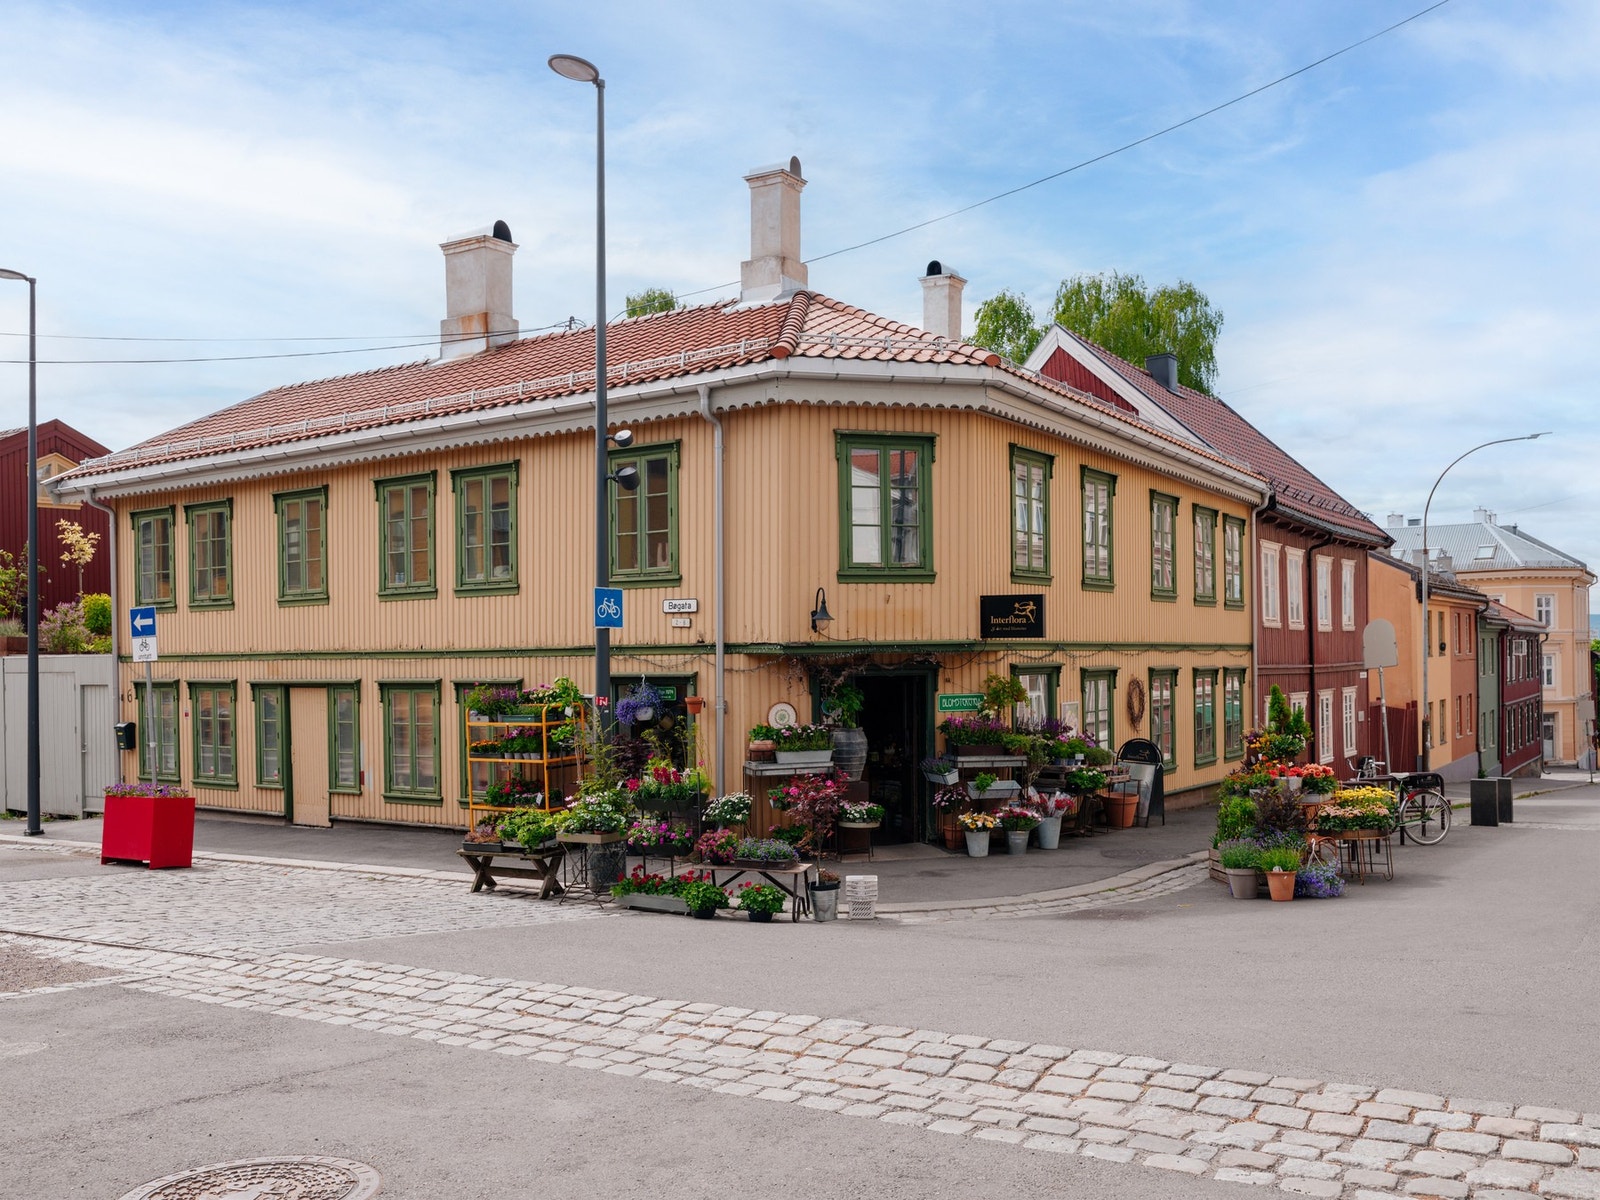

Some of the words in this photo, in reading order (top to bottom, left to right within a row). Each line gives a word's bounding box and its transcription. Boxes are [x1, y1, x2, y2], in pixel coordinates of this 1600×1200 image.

[668, 601, 692, 611] Bøgata
[990, 615, 1027, 624] Interflora
[127, 689, 132, 703] 6
